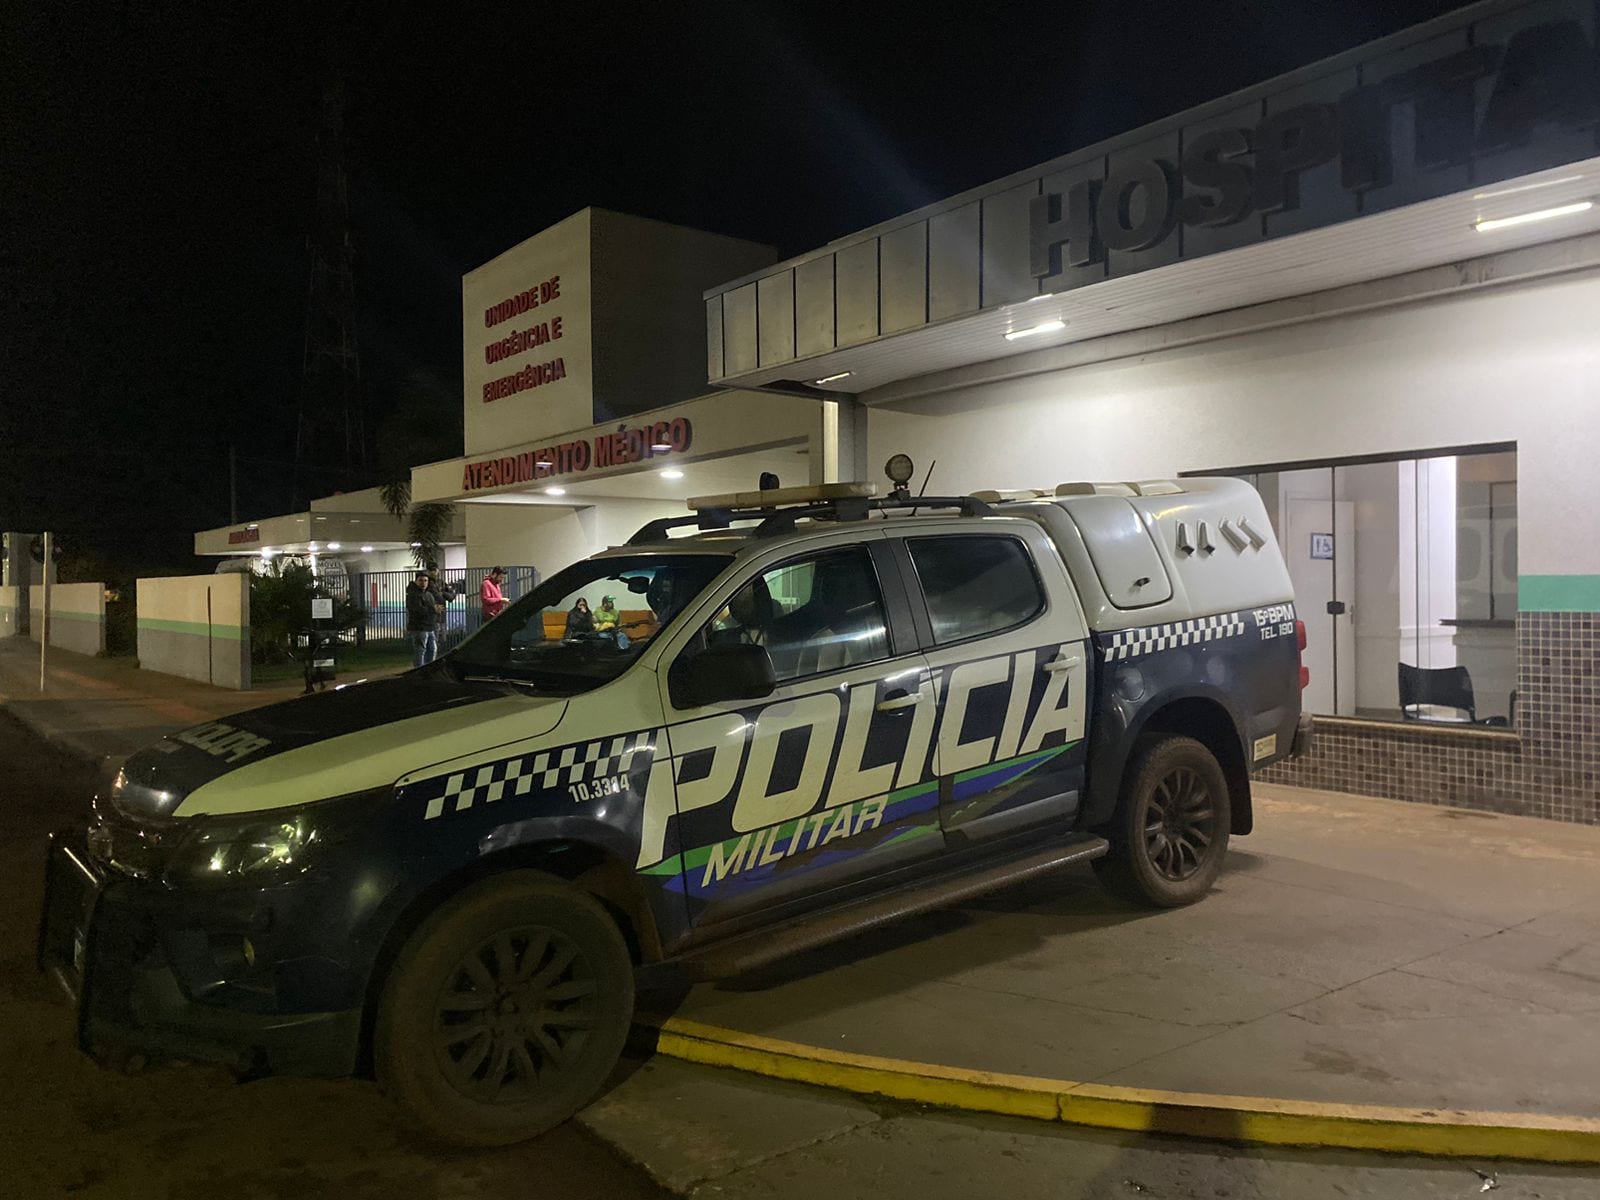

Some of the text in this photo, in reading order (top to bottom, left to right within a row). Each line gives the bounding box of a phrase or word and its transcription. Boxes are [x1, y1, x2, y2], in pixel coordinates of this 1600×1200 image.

[1029, 17, 1600, 279] HOSPITA
[484, 275, 561, 329] UNIDADE DE
[485, 316, 562, 365] URGÊNCIA E
[482, 357, 567, 403] EMERGÊNCIA
[462, 417, 692, 491] ATENDIMENTO MÉDICO
[701, 794, 890, 888] MILITAR
